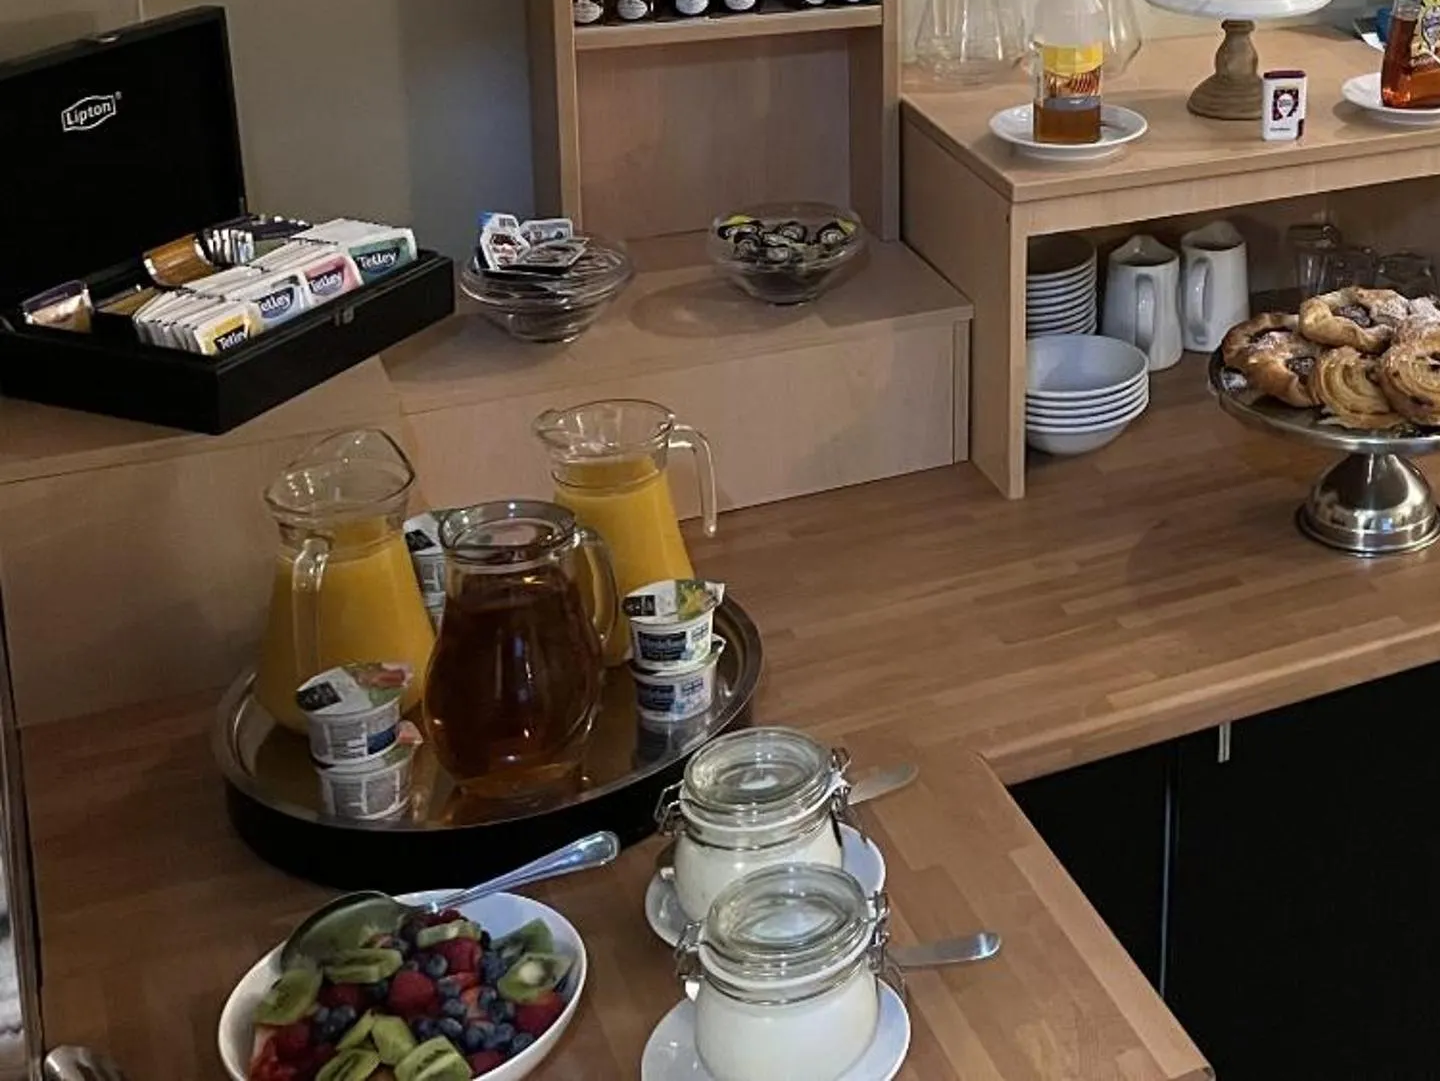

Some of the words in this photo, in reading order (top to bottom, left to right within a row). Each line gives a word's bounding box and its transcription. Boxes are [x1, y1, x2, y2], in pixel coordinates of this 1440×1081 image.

[67, 102, 111, 125] Lipton
[357, 252, 396, 268] Tetley
[260, 293, 290, 311] etley
